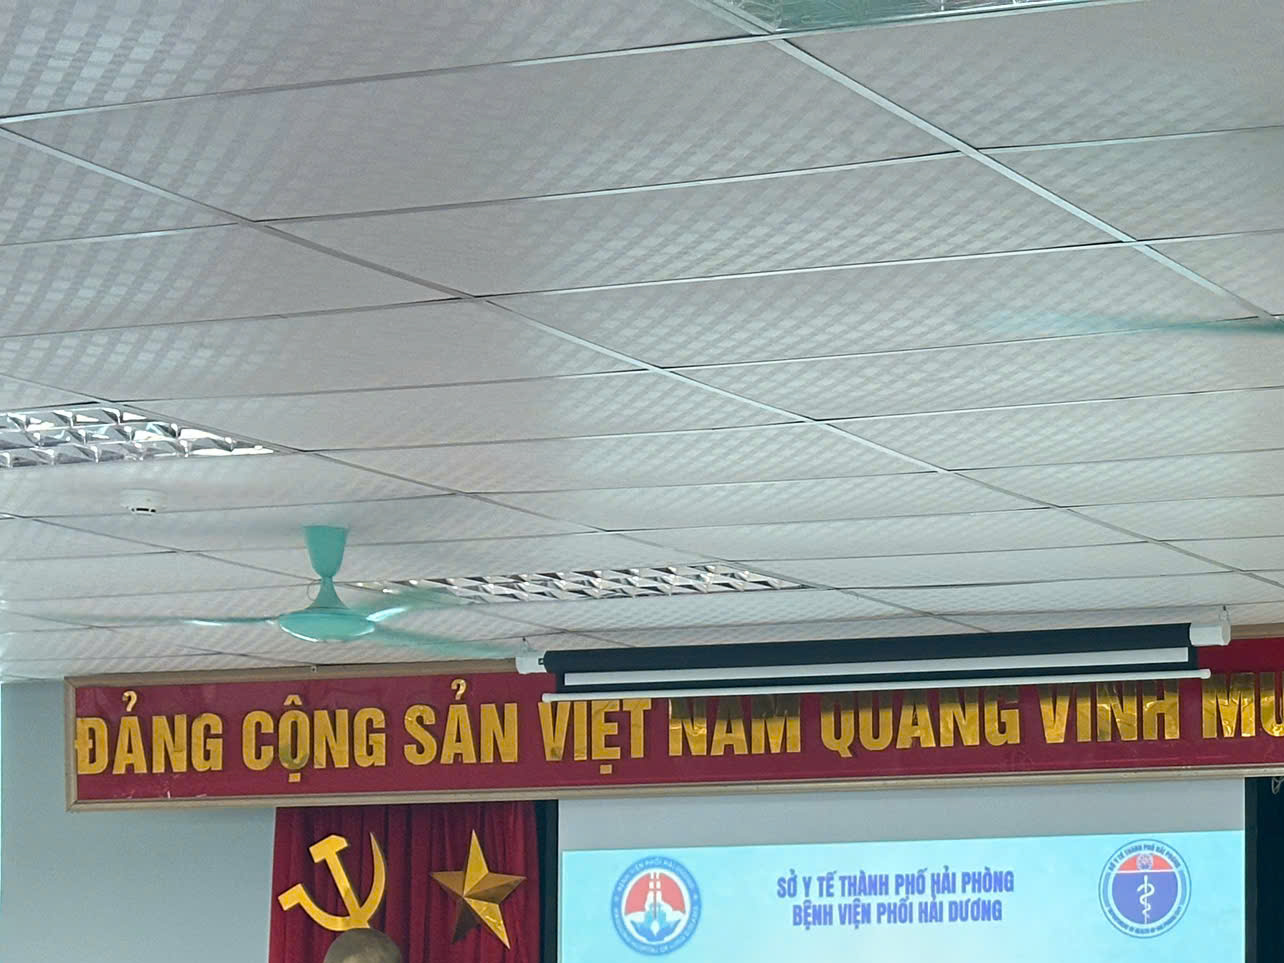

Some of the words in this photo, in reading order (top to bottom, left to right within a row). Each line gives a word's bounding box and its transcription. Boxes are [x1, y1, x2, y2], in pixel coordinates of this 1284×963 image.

[75, 690, 223, 775] ĐẢNG
[242, 694, 386, 783] CỘNG
[403, 678, 519, 765] SẢN
[669, 695, 801, 757] NAM
[820, 687, 1020, 758] QUANG
[1039, 681, 1180, 744] VINH
[777, 868, 798, 898] SỞ
[803, 876, 812, 898] Y
[817, 870, 837, 897] TẾ
[839, 869, 889, 896] THÀNH
[894, 868, 928, 896] PHỐ
[930, 865, 957, 895] HẢI
[961, 867, 1014, 893] PHÒNG
[792, 899, 833, 930] BỆNH
[838, 898, 871, 930] VIỆN
[948, 898, 1002, 921] DƯƠNG
